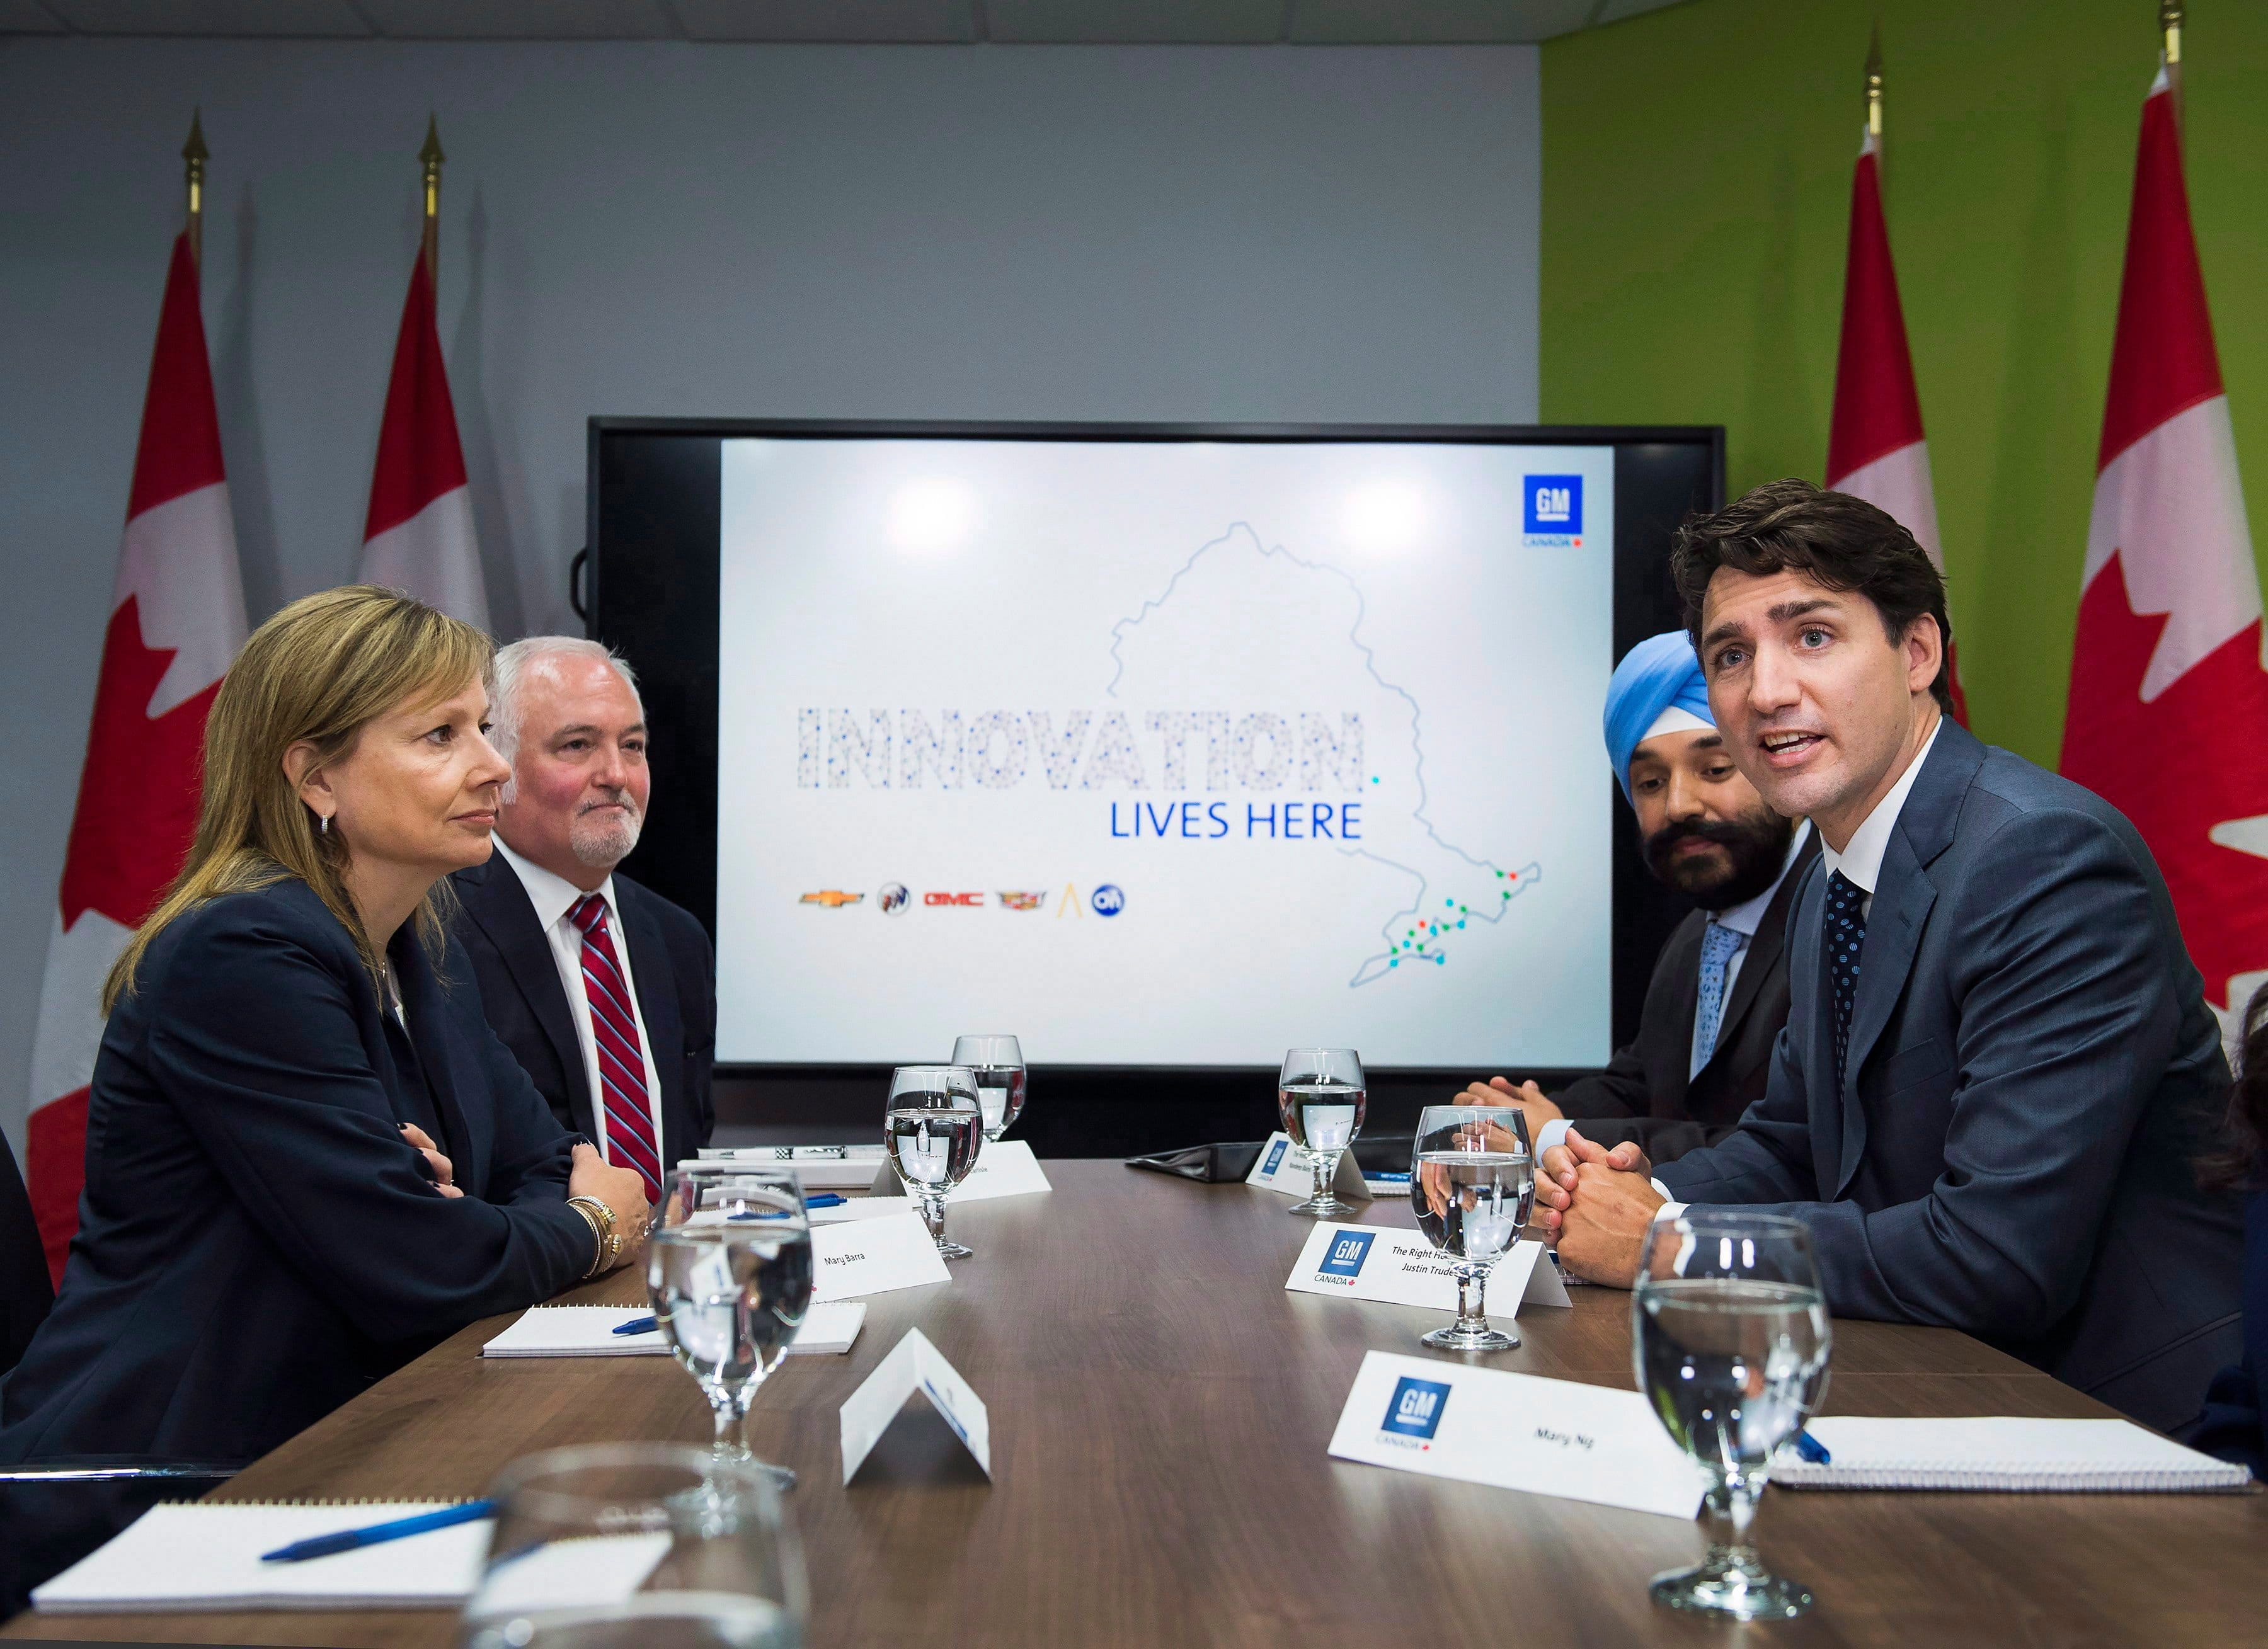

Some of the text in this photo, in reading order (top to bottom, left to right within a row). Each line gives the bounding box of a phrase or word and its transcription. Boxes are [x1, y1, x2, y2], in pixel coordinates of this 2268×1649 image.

[1536, 488, 1570, 513] GM
[1111, 801, 1362, 840] LIVES HERE
[1334, 1240, 1364, 1260] GM
[1392, 1246, 1407, 1256] The
[1409, 1248, 1433, 1260] Right
[824, 1253, 866, 1265] Mary Barra
[1401, 1262, 1455, 1276] Justin Trude
[1314, 1274, 1348, 1286] CANADA
[1399, 1388, 1438, 1418] GM
